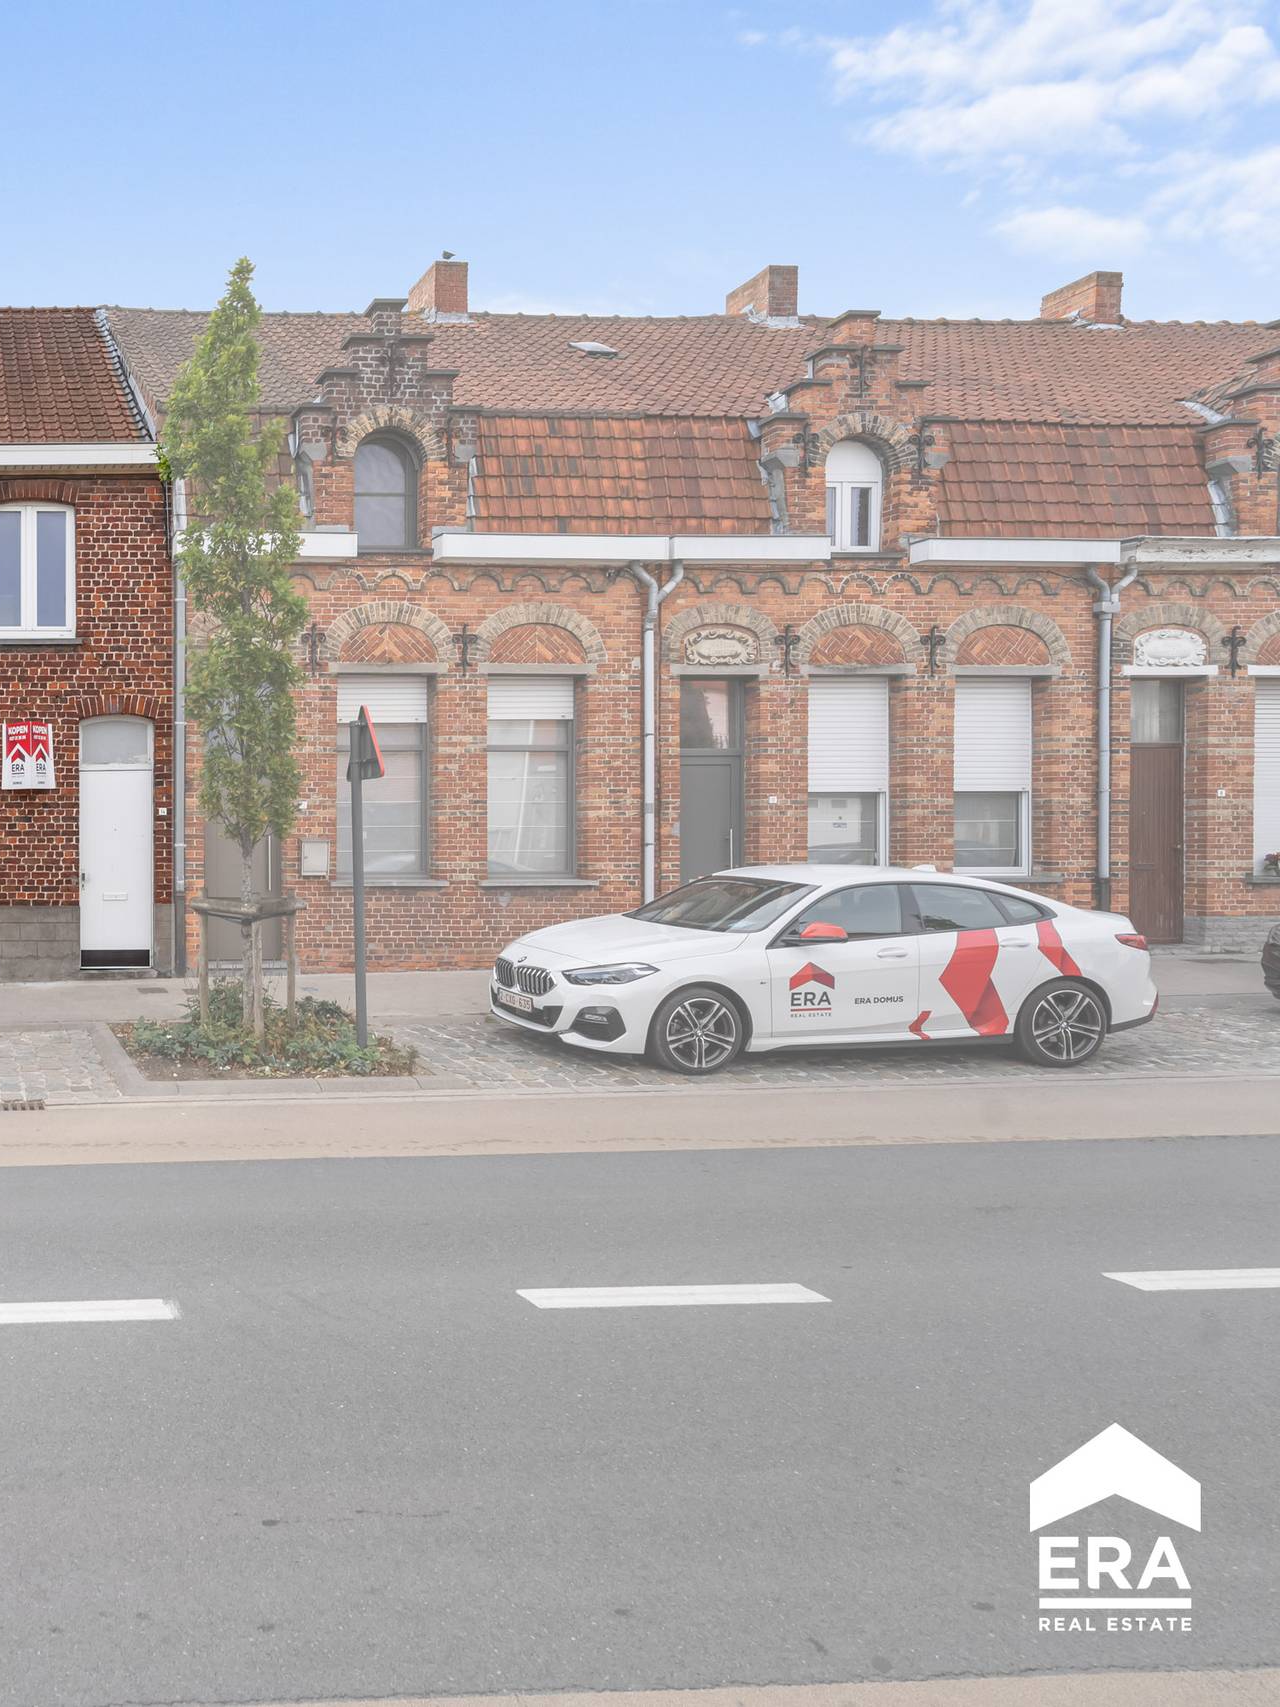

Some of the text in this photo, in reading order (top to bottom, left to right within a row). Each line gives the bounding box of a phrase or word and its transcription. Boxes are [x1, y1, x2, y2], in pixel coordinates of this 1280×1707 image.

[8, 725, 28, 735] KOPEN
[11, 764, 25, 772] ERA
[36, 763, 46, 772] ERA
[790, 991, 832, 1006] ERA
[873, 996, 904, 1004] DOMUS
